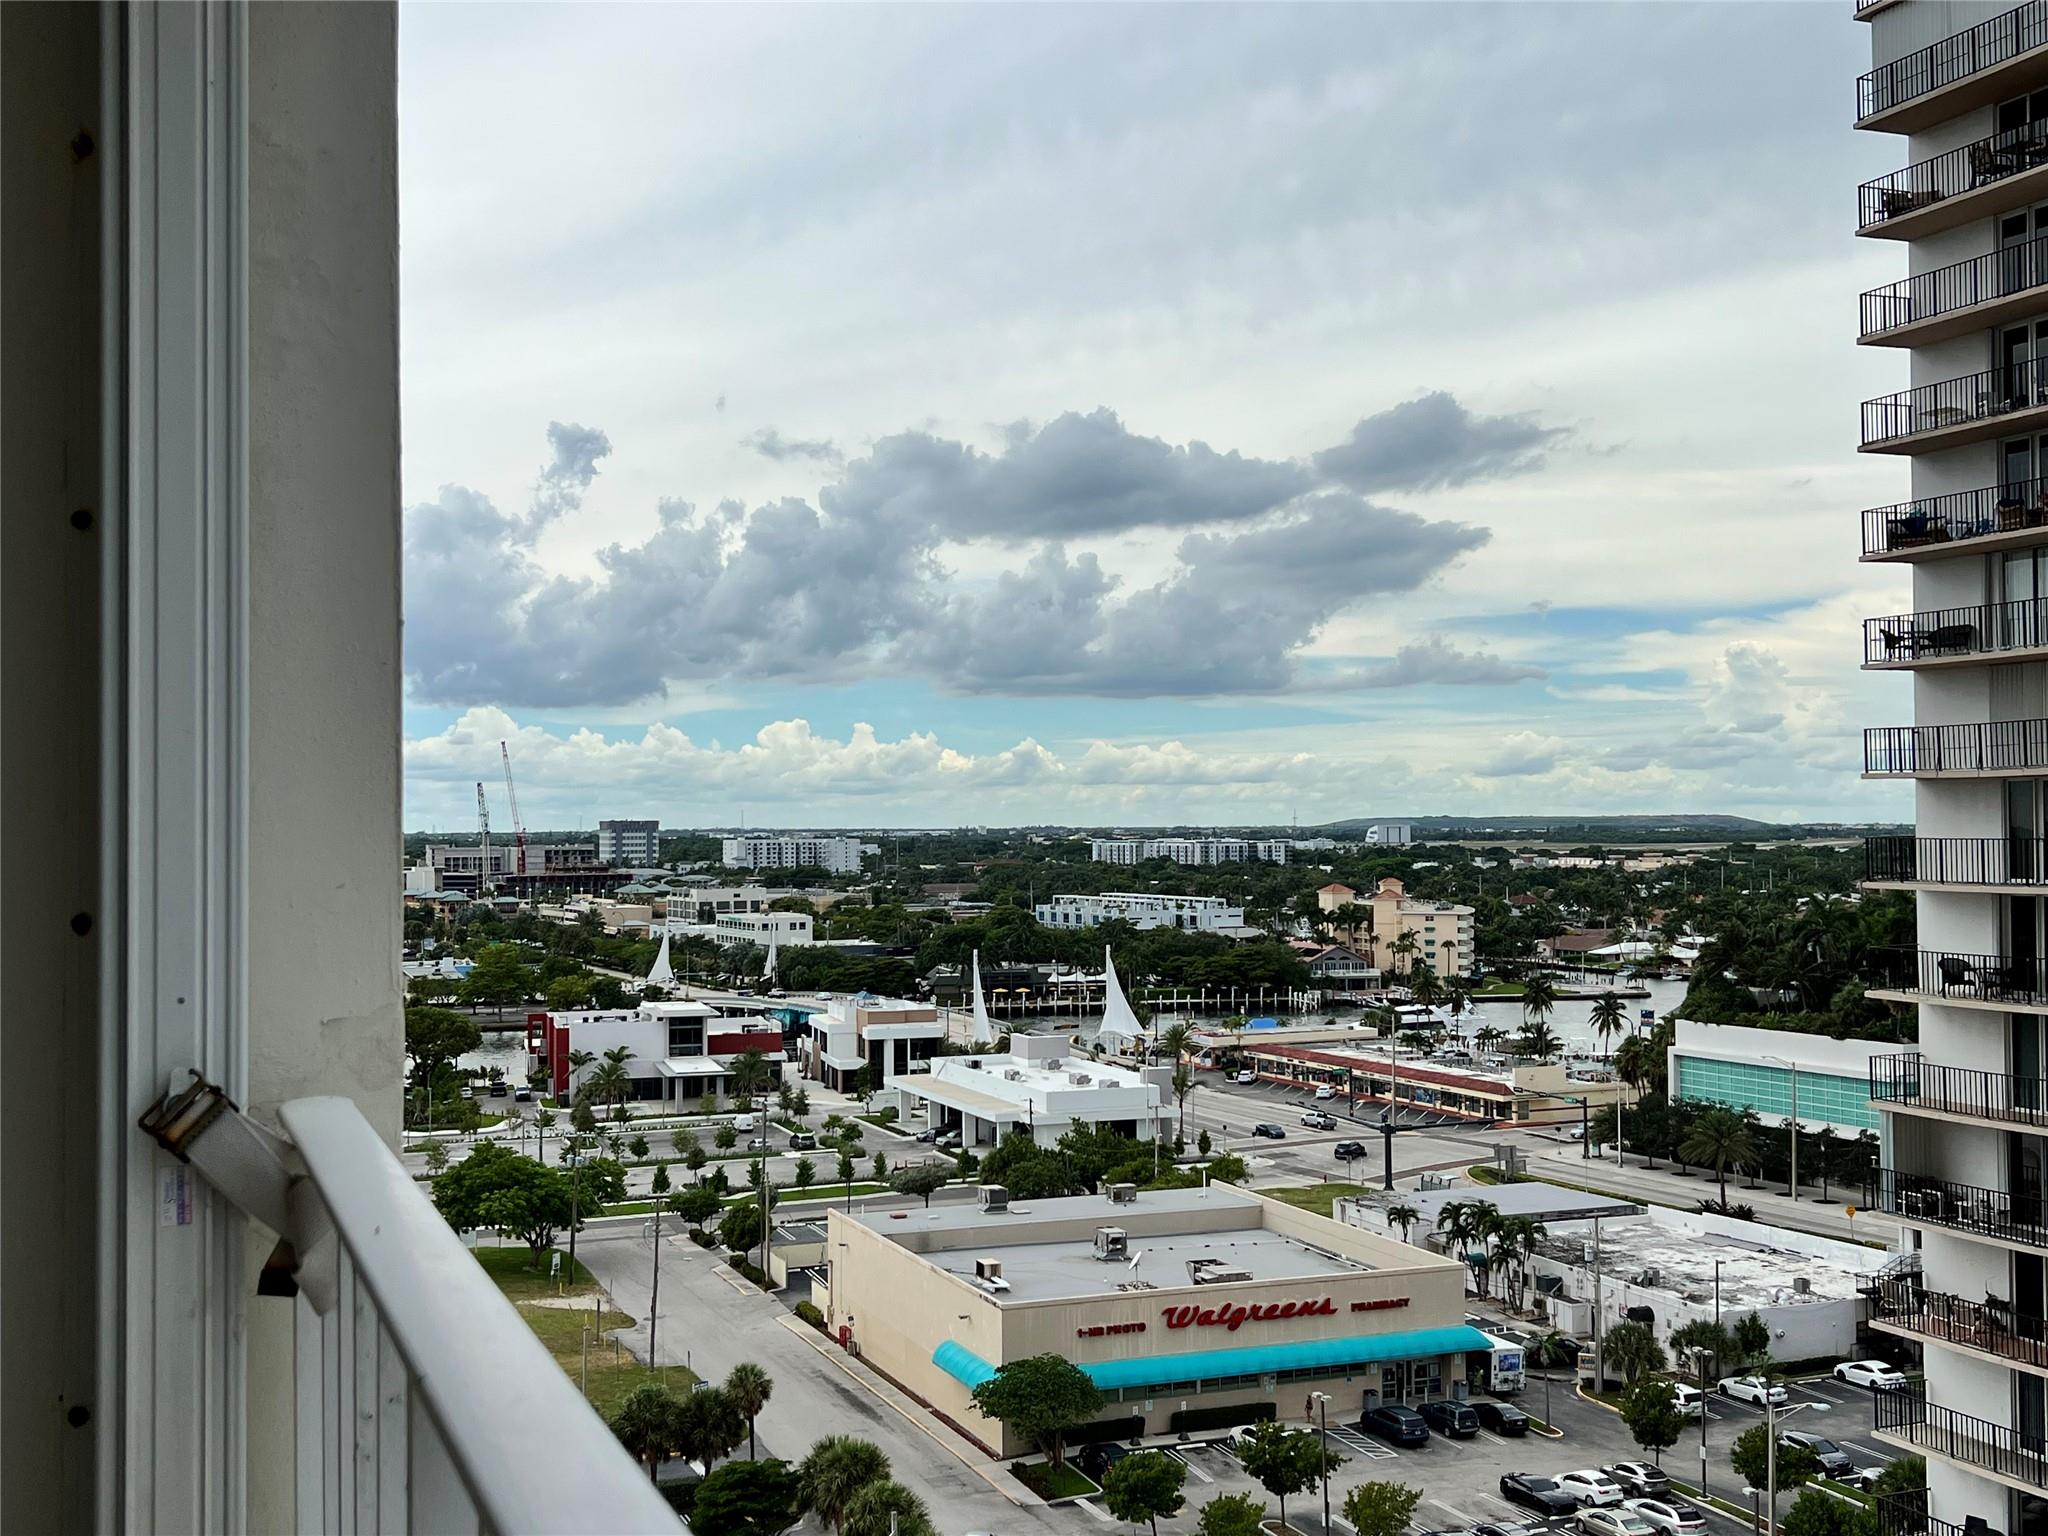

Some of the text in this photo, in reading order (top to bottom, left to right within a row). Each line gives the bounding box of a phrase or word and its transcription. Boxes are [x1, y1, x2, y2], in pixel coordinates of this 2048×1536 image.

[1350, 1298, 1410, 1313] PHARMACY
[1161, 1298, 1338, 1332] Walgreens
[1106, 1322, 1146, 1335] PHOTO
